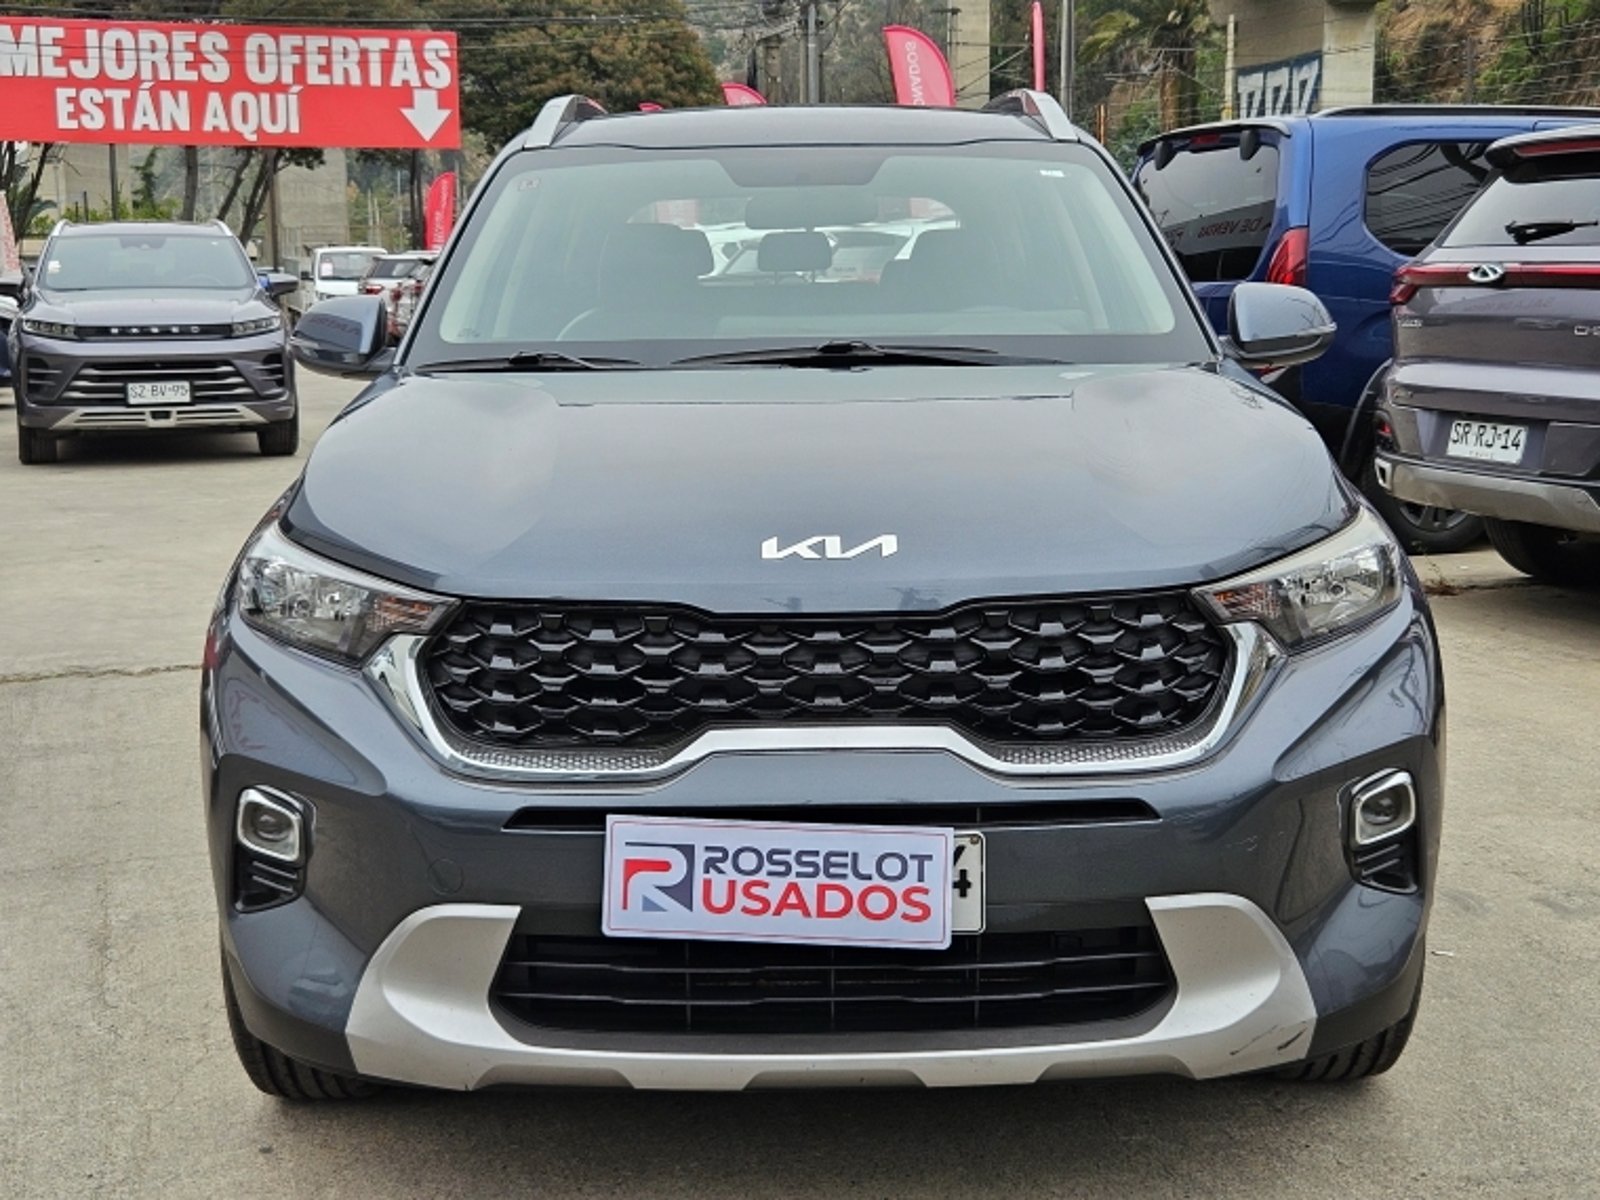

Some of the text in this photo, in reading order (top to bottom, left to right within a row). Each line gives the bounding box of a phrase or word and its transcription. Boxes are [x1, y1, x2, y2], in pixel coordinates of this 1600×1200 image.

[0, 24, 452, 89] MEJORES OFERTAS
[55, 80, 304, 142] ESTÁN AQUÍ
[761, 534, 898, 560] KIA
[702, 845, 934, 883] ROSSELOT
[702, 879, 933, 923] USADOS
